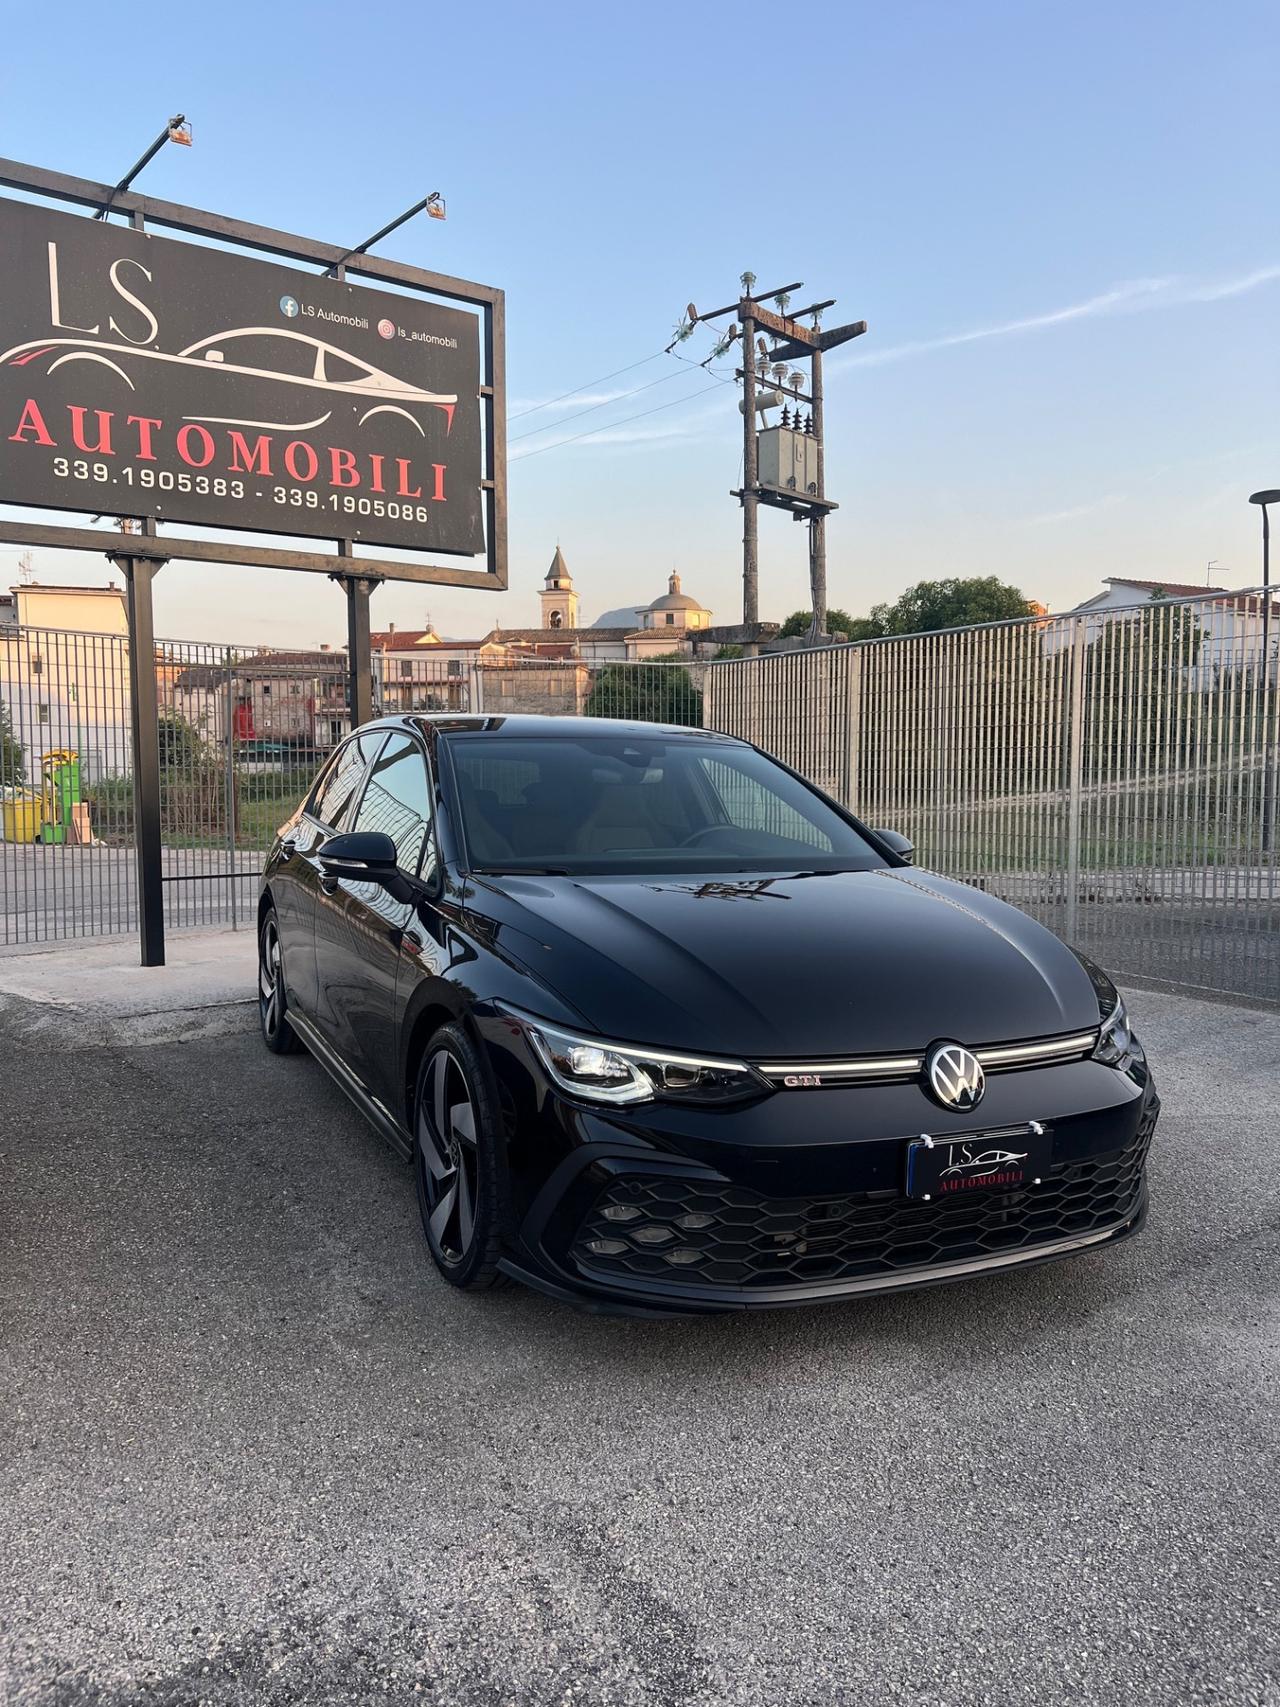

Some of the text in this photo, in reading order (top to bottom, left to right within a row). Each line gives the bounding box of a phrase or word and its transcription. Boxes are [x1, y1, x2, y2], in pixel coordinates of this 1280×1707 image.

[301, 303, 369, 329] LS Automobili
[397, 326, 458, 349] ls_automobili
[8, 398, 448, 502] AUTOMOBILI
[53, 457, 245, 499] 339.1905383
[273, 486, 428, 523] 339.1905086
[784, 1074, 821, 1087] GTI
[948, 1143, 974, 1166] LS
[940, 1170, 1025, 1192] AUTOMOBILI
